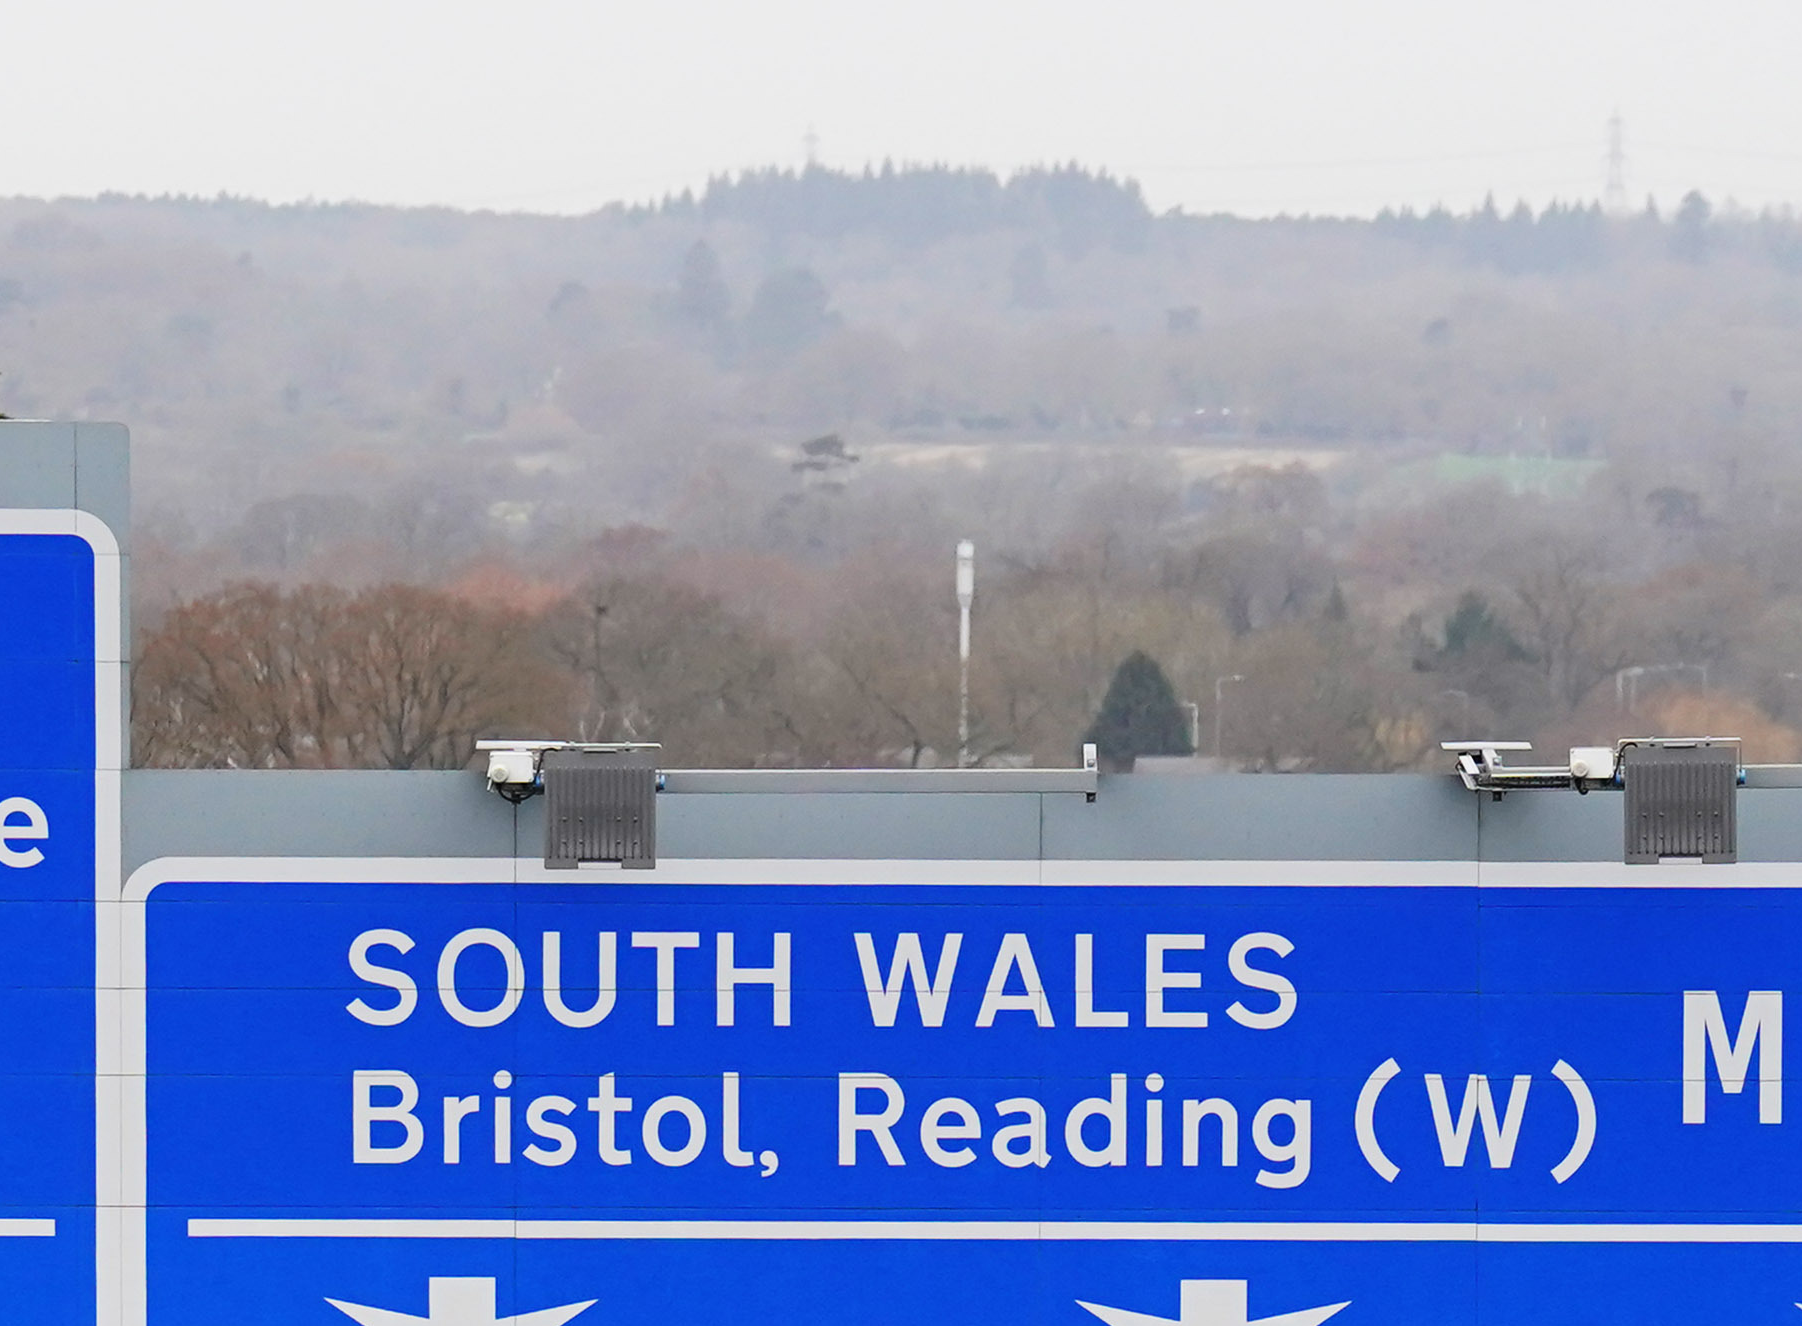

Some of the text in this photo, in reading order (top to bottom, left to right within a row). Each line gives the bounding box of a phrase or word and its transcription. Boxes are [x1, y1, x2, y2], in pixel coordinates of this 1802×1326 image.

[346, 928, 1297, 1030] SOUTH WALES
[352, 1057, 1597, 1189] Bristol, Reading (W)
